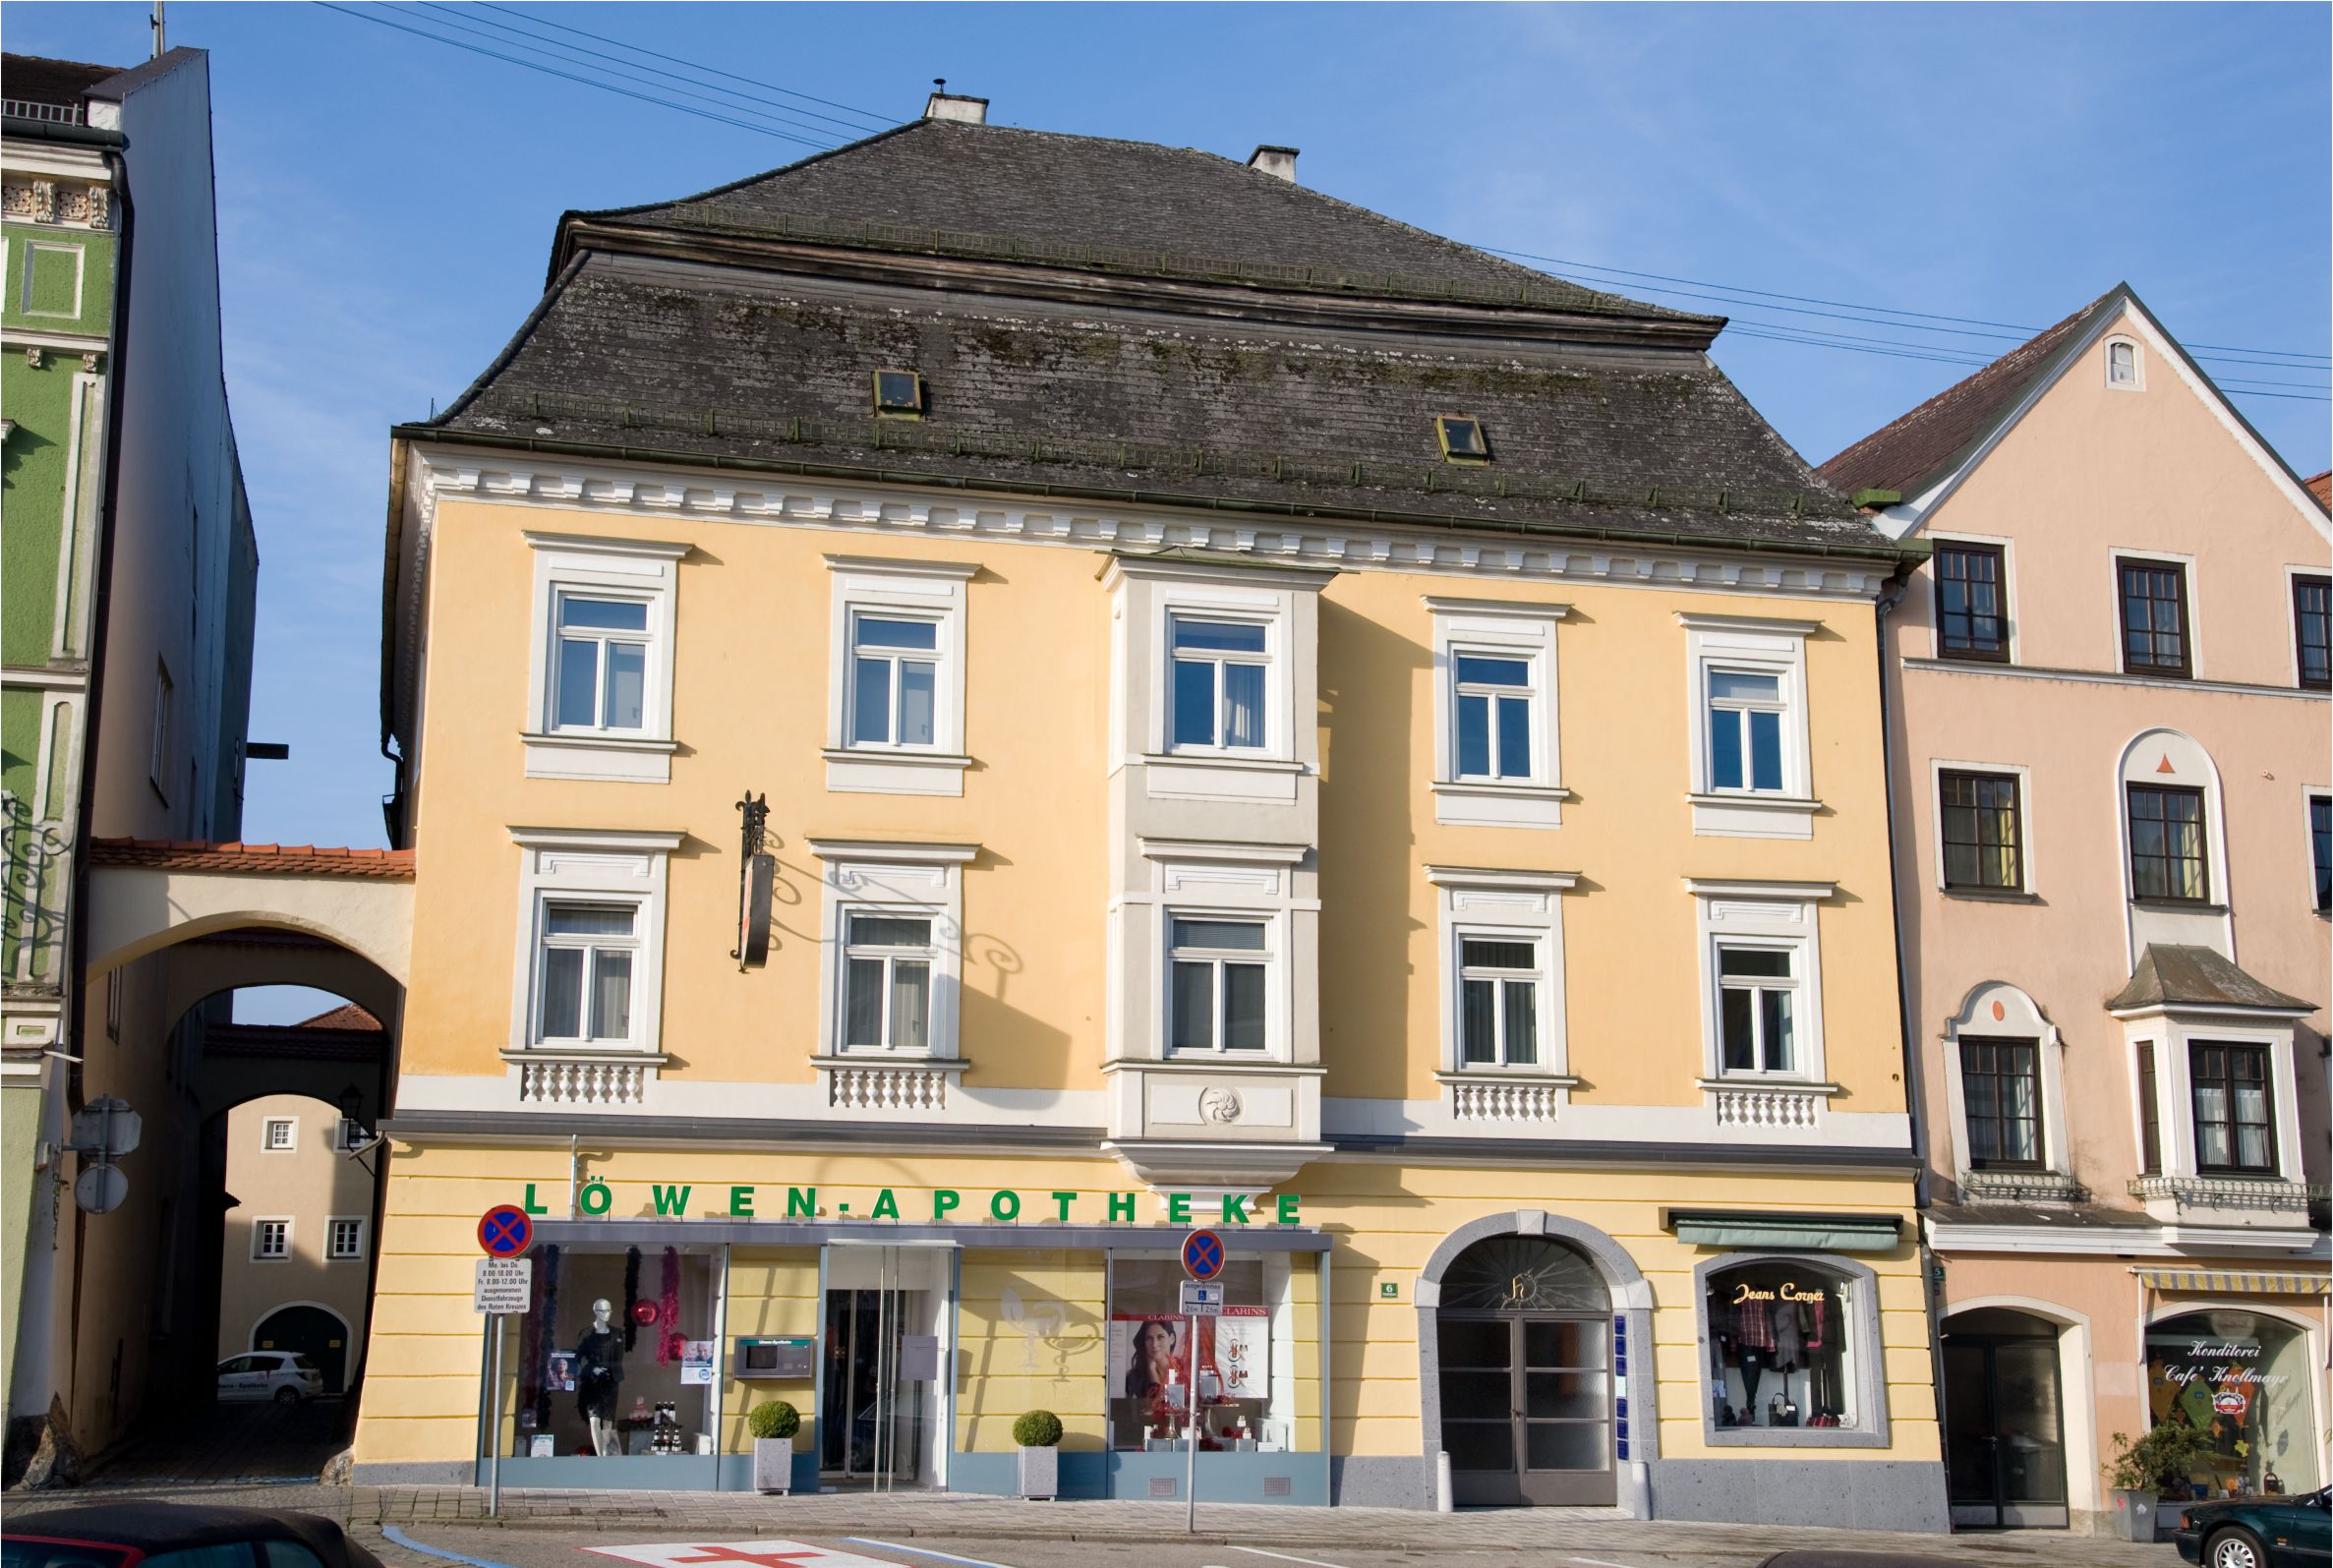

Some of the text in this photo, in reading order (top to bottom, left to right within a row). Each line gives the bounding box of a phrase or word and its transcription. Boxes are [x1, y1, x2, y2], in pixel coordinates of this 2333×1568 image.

[524, 1176, 1301, 1225] LÖWEN-APOTHEKE
[1386, 1284, 1393, 1292] 6
[1733, 1283, 1825, 1304] Jeans Corner
[2187, 1340, 2261, 1357] Konditorei
[2209, 1366, 2289, 1386] Knollmayr
